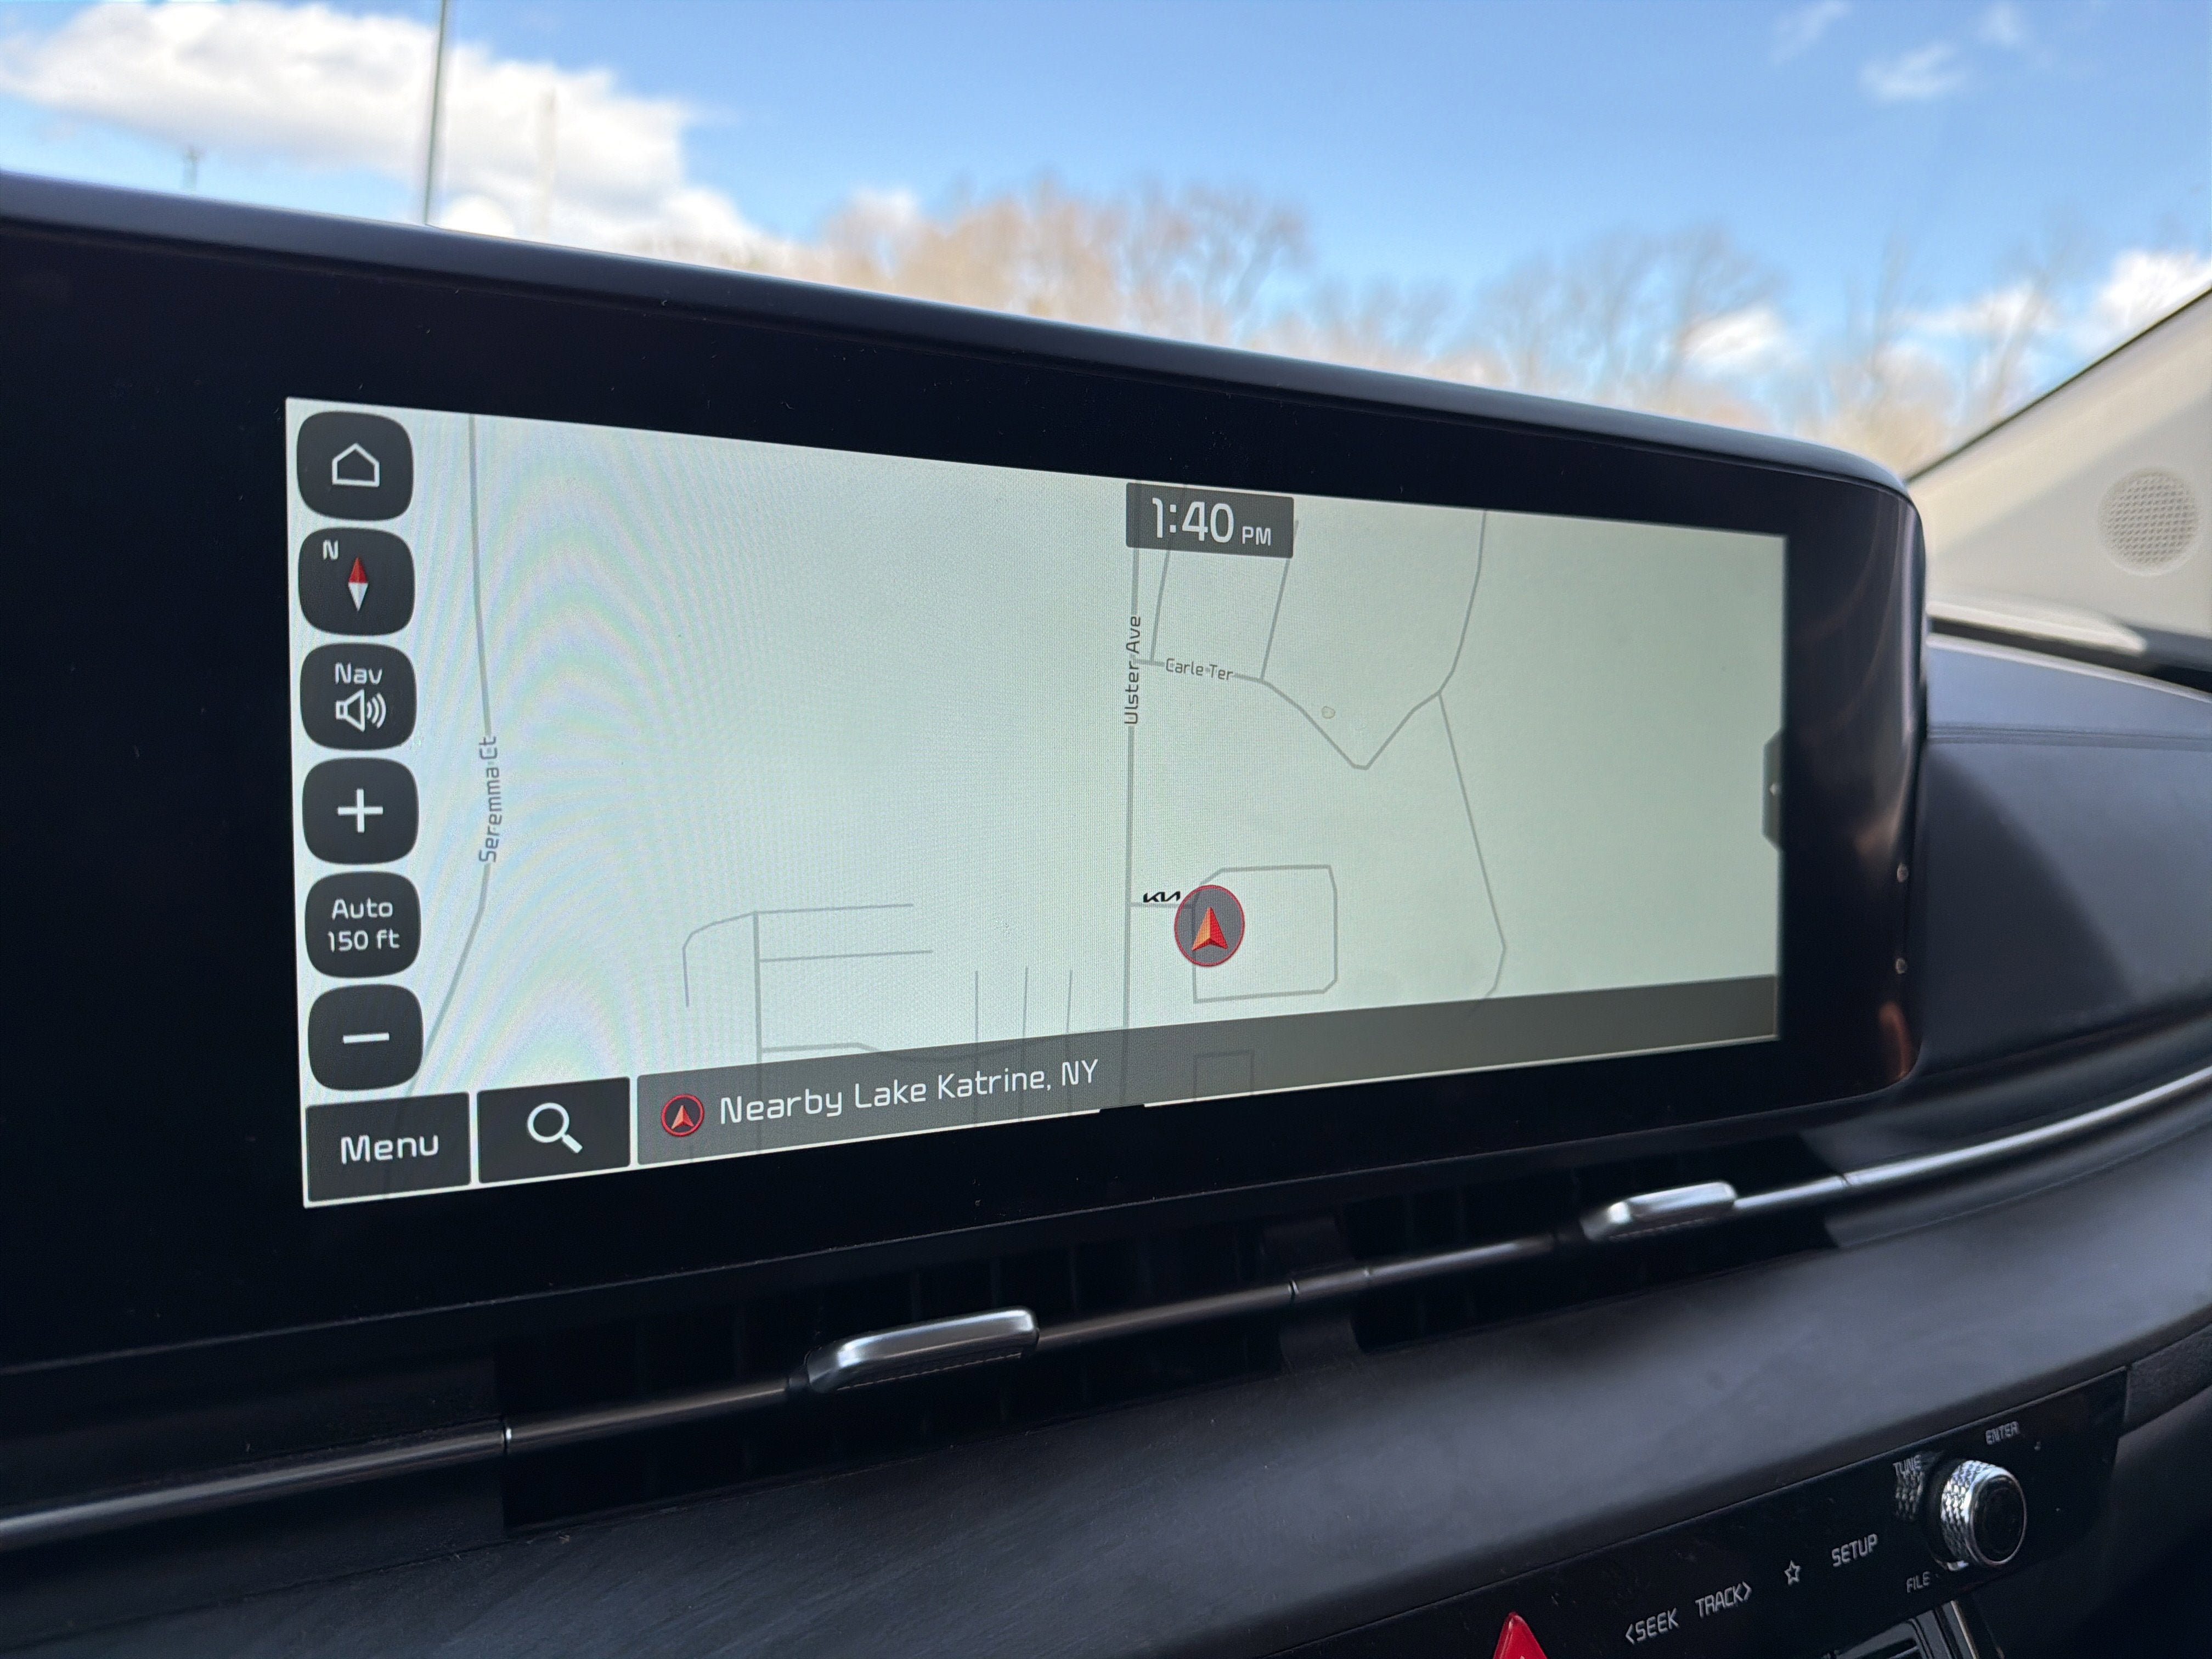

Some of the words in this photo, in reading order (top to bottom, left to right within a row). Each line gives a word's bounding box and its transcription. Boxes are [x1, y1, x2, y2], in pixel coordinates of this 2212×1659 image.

[1152, 498, 1234, 543] 1:40
[1242, 526, 1271, 546] PM
[323, 540, 339, 560] N
[1126, 615, 1141, 653] Ave
[335, 663, 383, 685] Nav
[1165, 658, 1204, 676] Carle
[1209, 664, 1234, 680] Ter
[1124, 661, 1139, 725] Ulster
[479, 736, 498, 760] Ct
[479, 766, 502, 862] Seremma
[331, 898, 393, 920] Auto
[328, 930, 369, 952] 150
[377, 928, 400, 949] ft
[720, 1089, 842, 1125] Nearby
[855, 1079, 926, 1109] Lake
[938, 1066, 1051, 1099] Katrine,
[1062, 1059, 1099, 1086] NY
[340, 1135, 439, 1164] Menu
[1985, 1421, 2020, 1445] ENTER
[1831, 1533, 1878, 1567] SETUP
[1906, 1571, 1931, 1593] FILE
